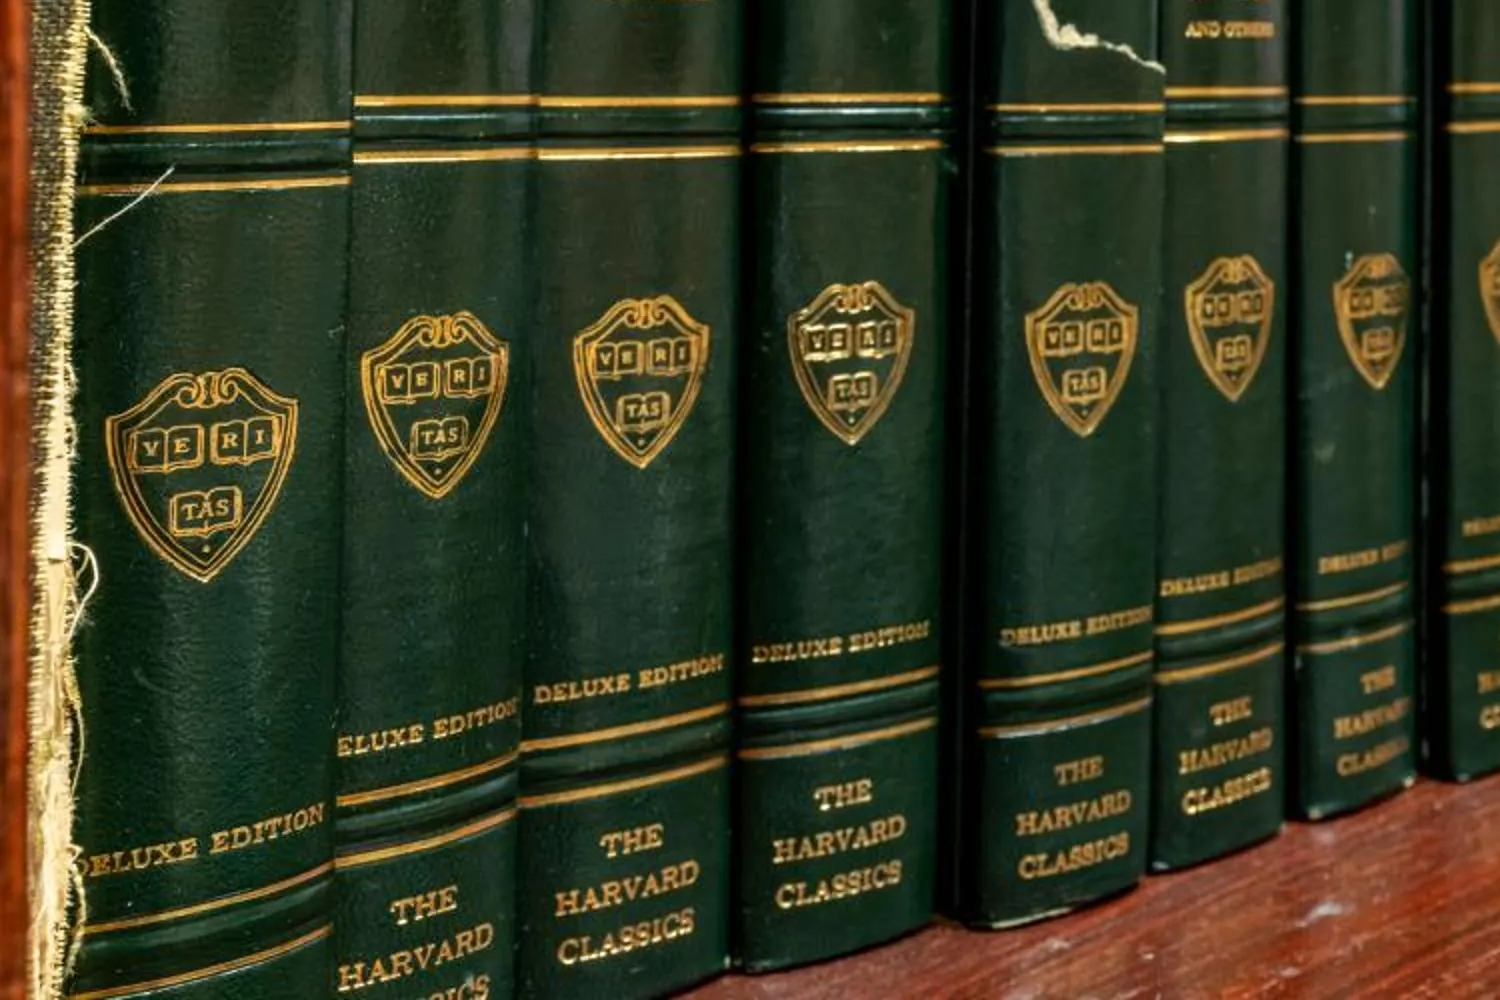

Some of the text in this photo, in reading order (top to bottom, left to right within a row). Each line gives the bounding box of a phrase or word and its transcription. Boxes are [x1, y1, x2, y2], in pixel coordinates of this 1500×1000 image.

[1185, 21, 1221, 38] AND
[627, 401, 660, 418] TAS
[420, 426, 459, 445] TAS
[181, 499, 230, 521] TAS
[752, 621, 930, 664] DELUXE EDITION
[1000, 619, 1081, 646] DELUXE
[533, 653, 724, 704] DELUXE EDITION
[337, 697, 517, 757] ELUXE EDITION
[1209, 695, 1252, 726] THE
[1055, 755, 1104, 786] THE
[1179, 727, 1273, 775] HARVARD
[813, 779, 873, 811] THE
[1015, 790, 1131, 836] HARVARD
[1181, 766, 1272, 815] CLASSICS
[209, 803, 325, 854] EDITION
[600, 824, 664, 859] THE
[772, 815, 907, 864] HARVARD
[1017, 831, 1130, 879] CLASSICS
[389, 885, 458, 926] THE
[555, 860, 700, 917] HARVARD
[775, 860, 902, 910] CLASSICS
[337, 922, 494, 992] HARVARD
[557, 908, 695, 966] CLASSICS
